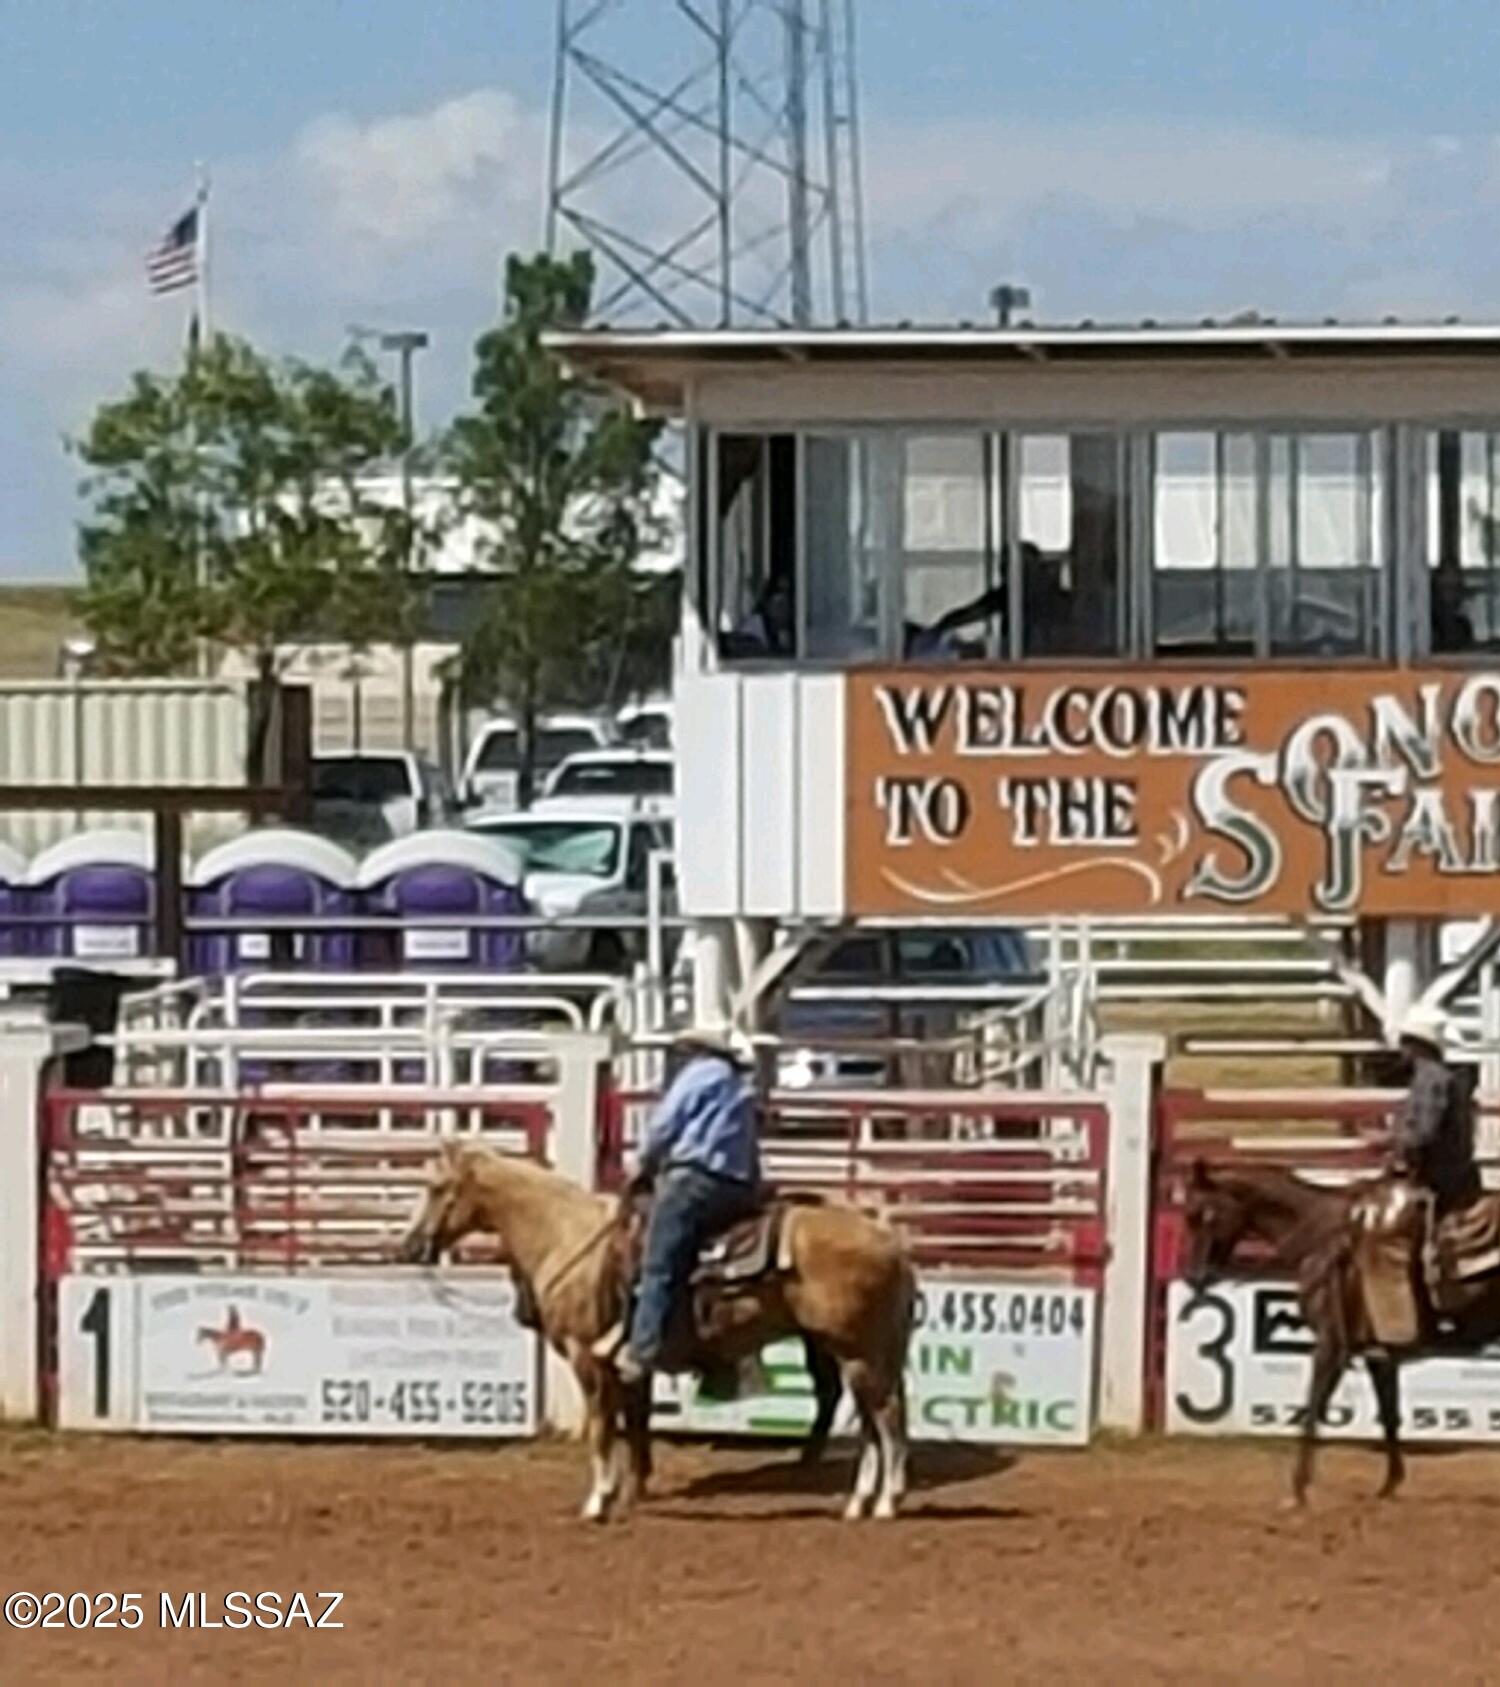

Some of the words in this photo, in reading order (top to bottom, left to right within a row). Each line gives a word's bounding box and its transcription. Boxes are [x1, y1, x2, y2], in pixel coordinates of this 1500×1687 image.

[874, 684, 1248, 756] WELCOME
[874, 775, 971, 847] TO
[1000, 775, 1140, 847] THE
[911, 1291, 1085, 1337] 0.455.0404
[80, 1287, 110, 1419] 1
[919, 1346, 973, 1375] IN
[1175, 1294, 1236, 1424] 3
[921, 1396, 1076, 1431] CTRIC
